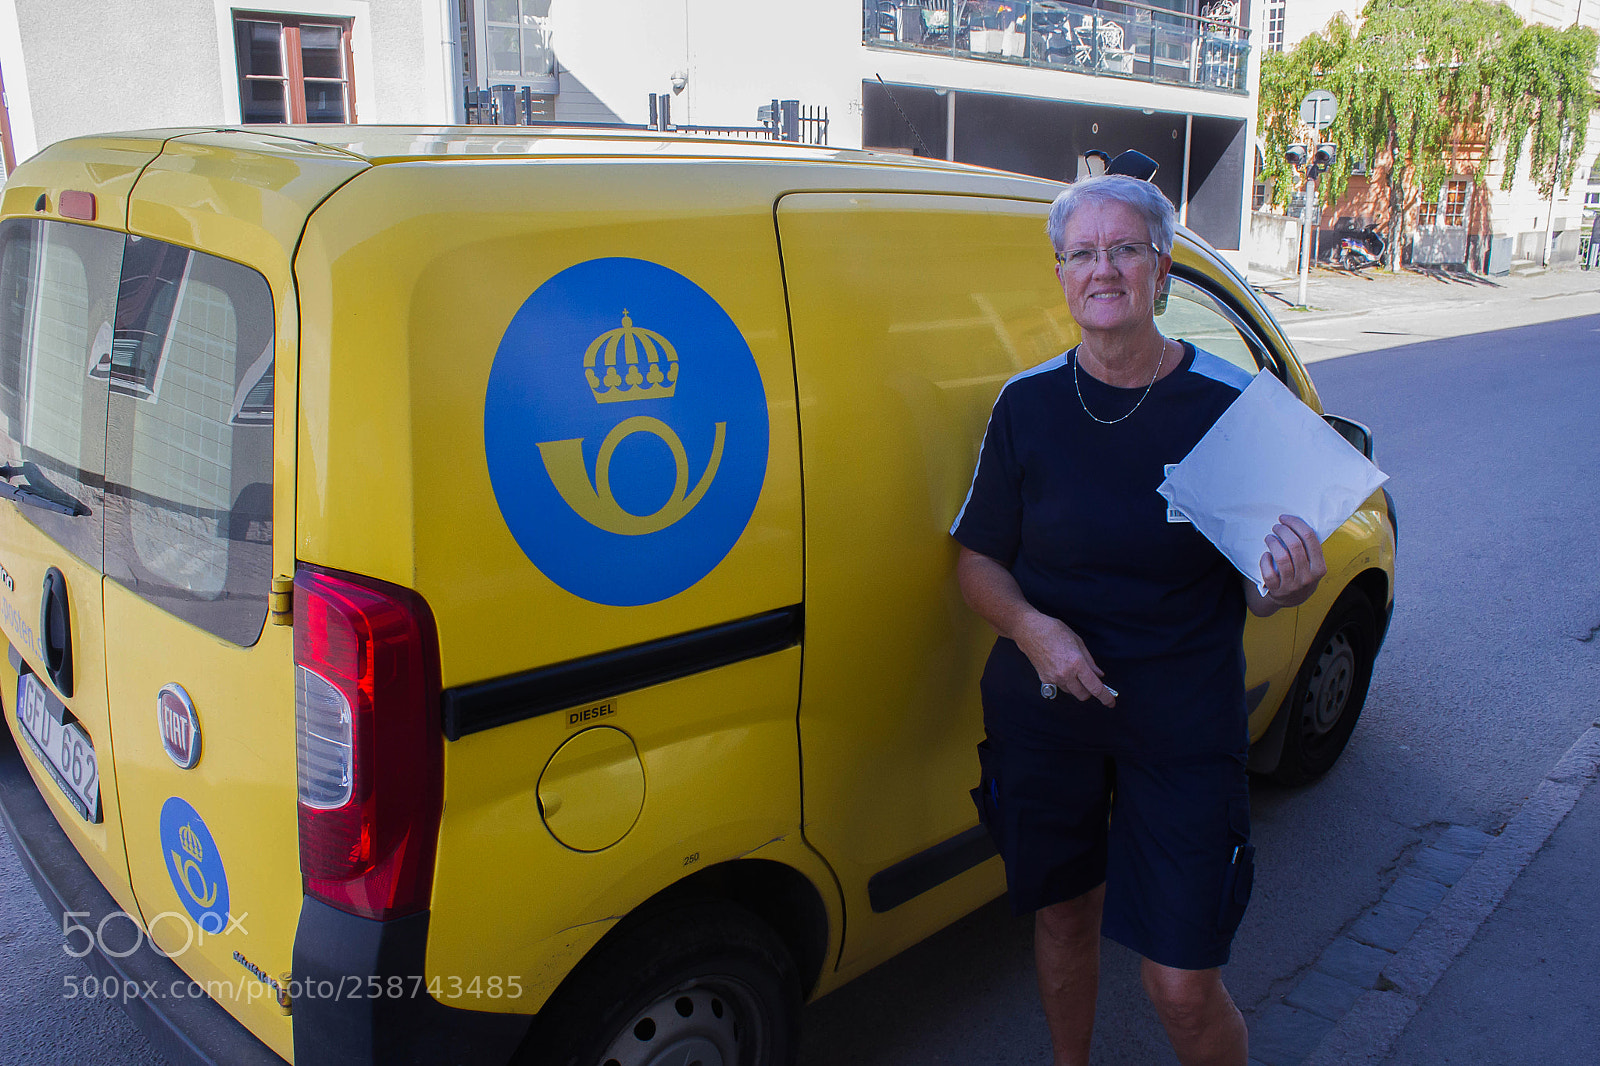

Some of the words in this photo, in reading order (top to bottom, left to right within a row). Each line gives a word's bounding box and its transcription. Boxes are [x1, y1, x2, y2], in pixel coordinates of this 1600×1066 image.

[163, 705, 189, 751] FIAT
[570, 703, 614, 724] DIESEL
[61, 726, 97, 806] 662
[683, 852, 699, 866] 250
